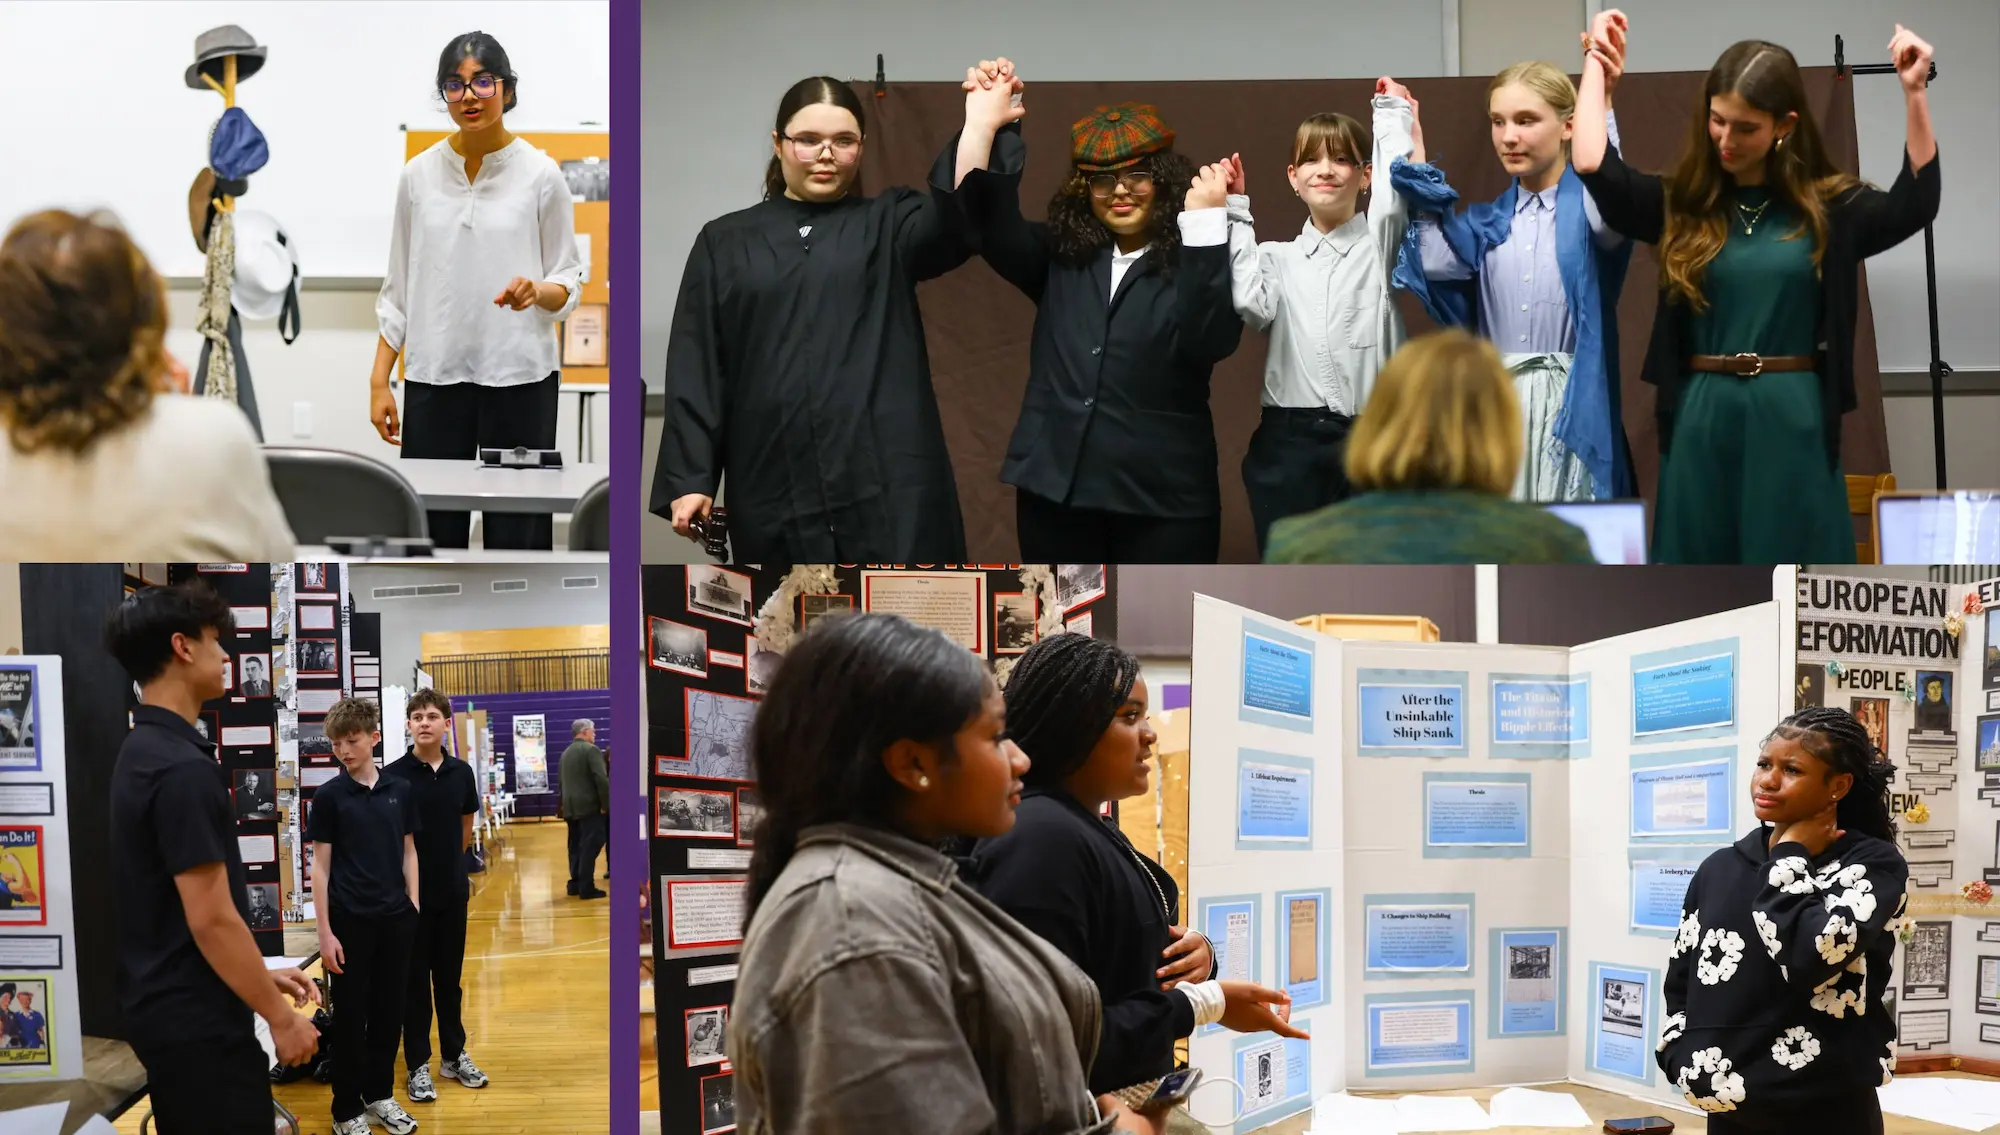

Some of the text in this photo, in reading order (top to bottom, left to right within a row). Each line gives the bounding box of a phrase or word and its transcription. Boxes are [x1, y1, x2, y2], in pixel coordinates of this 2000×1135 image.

[1798, 577, 1946, 618] EUROPEAN
[1798, 620, 1959, 659] EFORMATION
[1837, 668, 1906, 692] PEOPLE
[1400, 694, 1454, 706] After the
[1500, 692, 1560, 702] The Titanic
[1386, 710, 1454, 722] Unsinkable
[1500, 706, 1575, 718] and Historical
[1394, 727, 1454, 740] Ship Sank
[1501, 721, 1574, 734] Ripple Effects
[9, 831, 23, 842] Do
[24, 831, 35, 842] It!
